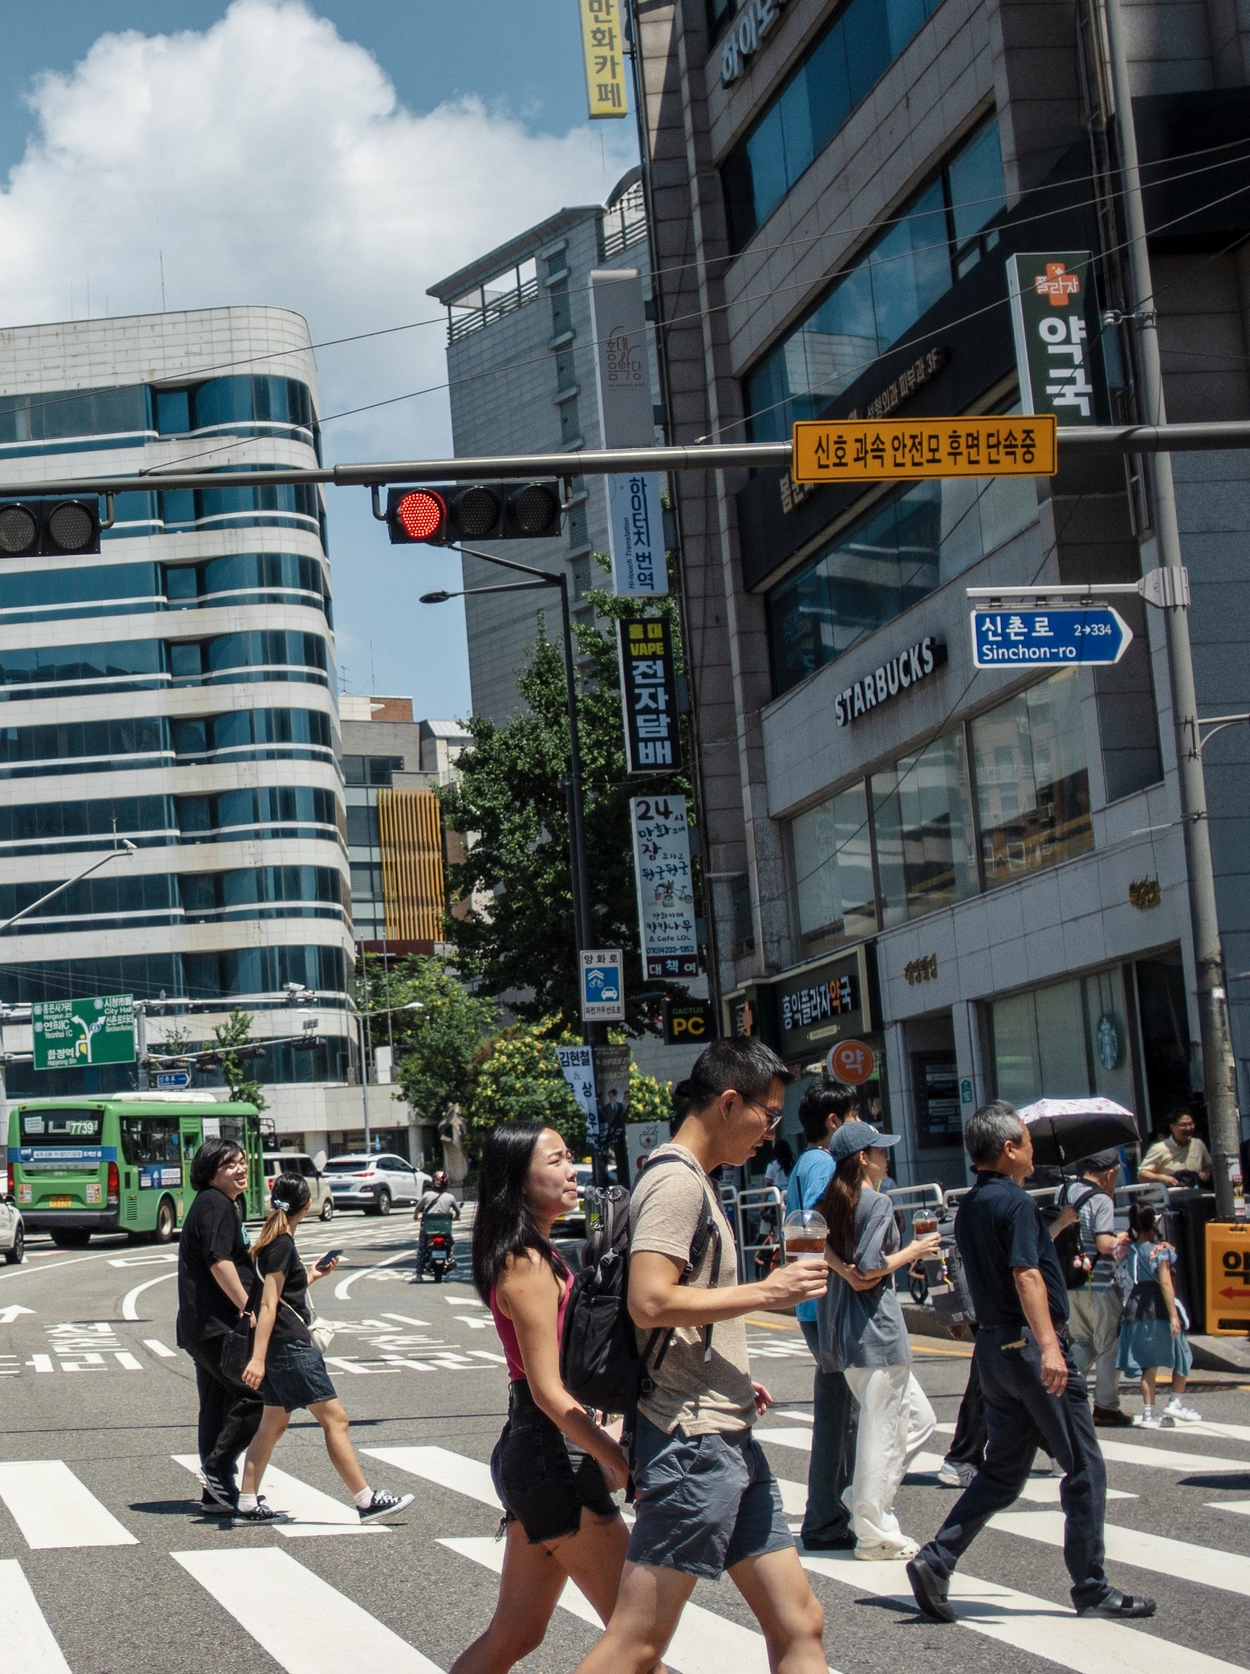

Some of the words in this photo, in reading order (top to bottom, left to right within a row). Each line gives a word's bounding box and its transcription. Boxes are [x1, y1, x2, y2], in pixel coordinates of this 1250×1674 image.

[588, 0, 622, 107] 만화카페
[1035, 275, 1079, 294] 플라자
[1038, 315, 1093, 416] 약국
[815, 433, 848, 468] 신호
[853, 432, 886, 468] 과속
[891, 431, 942, 467] 안전모
[947, 429, 980, 465] 후면
[986, 428, 1037, 464] 단속중
[629, 477, 651, 548] 하이터치
[636, 551, 655, 591] 번역
[981, 616, 1054, 641] 신촌로
[630, 642, 664, 656] VAPE
[982, 644, 1077, 660] Sinchon-ro
[834, 636, 934, 727] STARBUCKS
[632, 660, 673, 764] 전자담배
[583, 953, 619, 964] 양화로
[649, 963, 662, 975] 대
[665, 959, 679, 973] 책
[684, 962, 696, 973] 여
[104, 1007, 118, 1015] City
[585, 1005, 622, 1015] 자전거우선도로
[672, 1006, 704, 1015] CACTUS
[782, 975, 852, 1030] 홍익플라자약국
[673, 1017, 705, 1036] PC
[47, 1047, 74, 1060] 합정역
[559, 1050, 591, 1067] 김현철
[841, 1049, 864, 1075] 약
[71, 1122, 94, 1134] 7739
